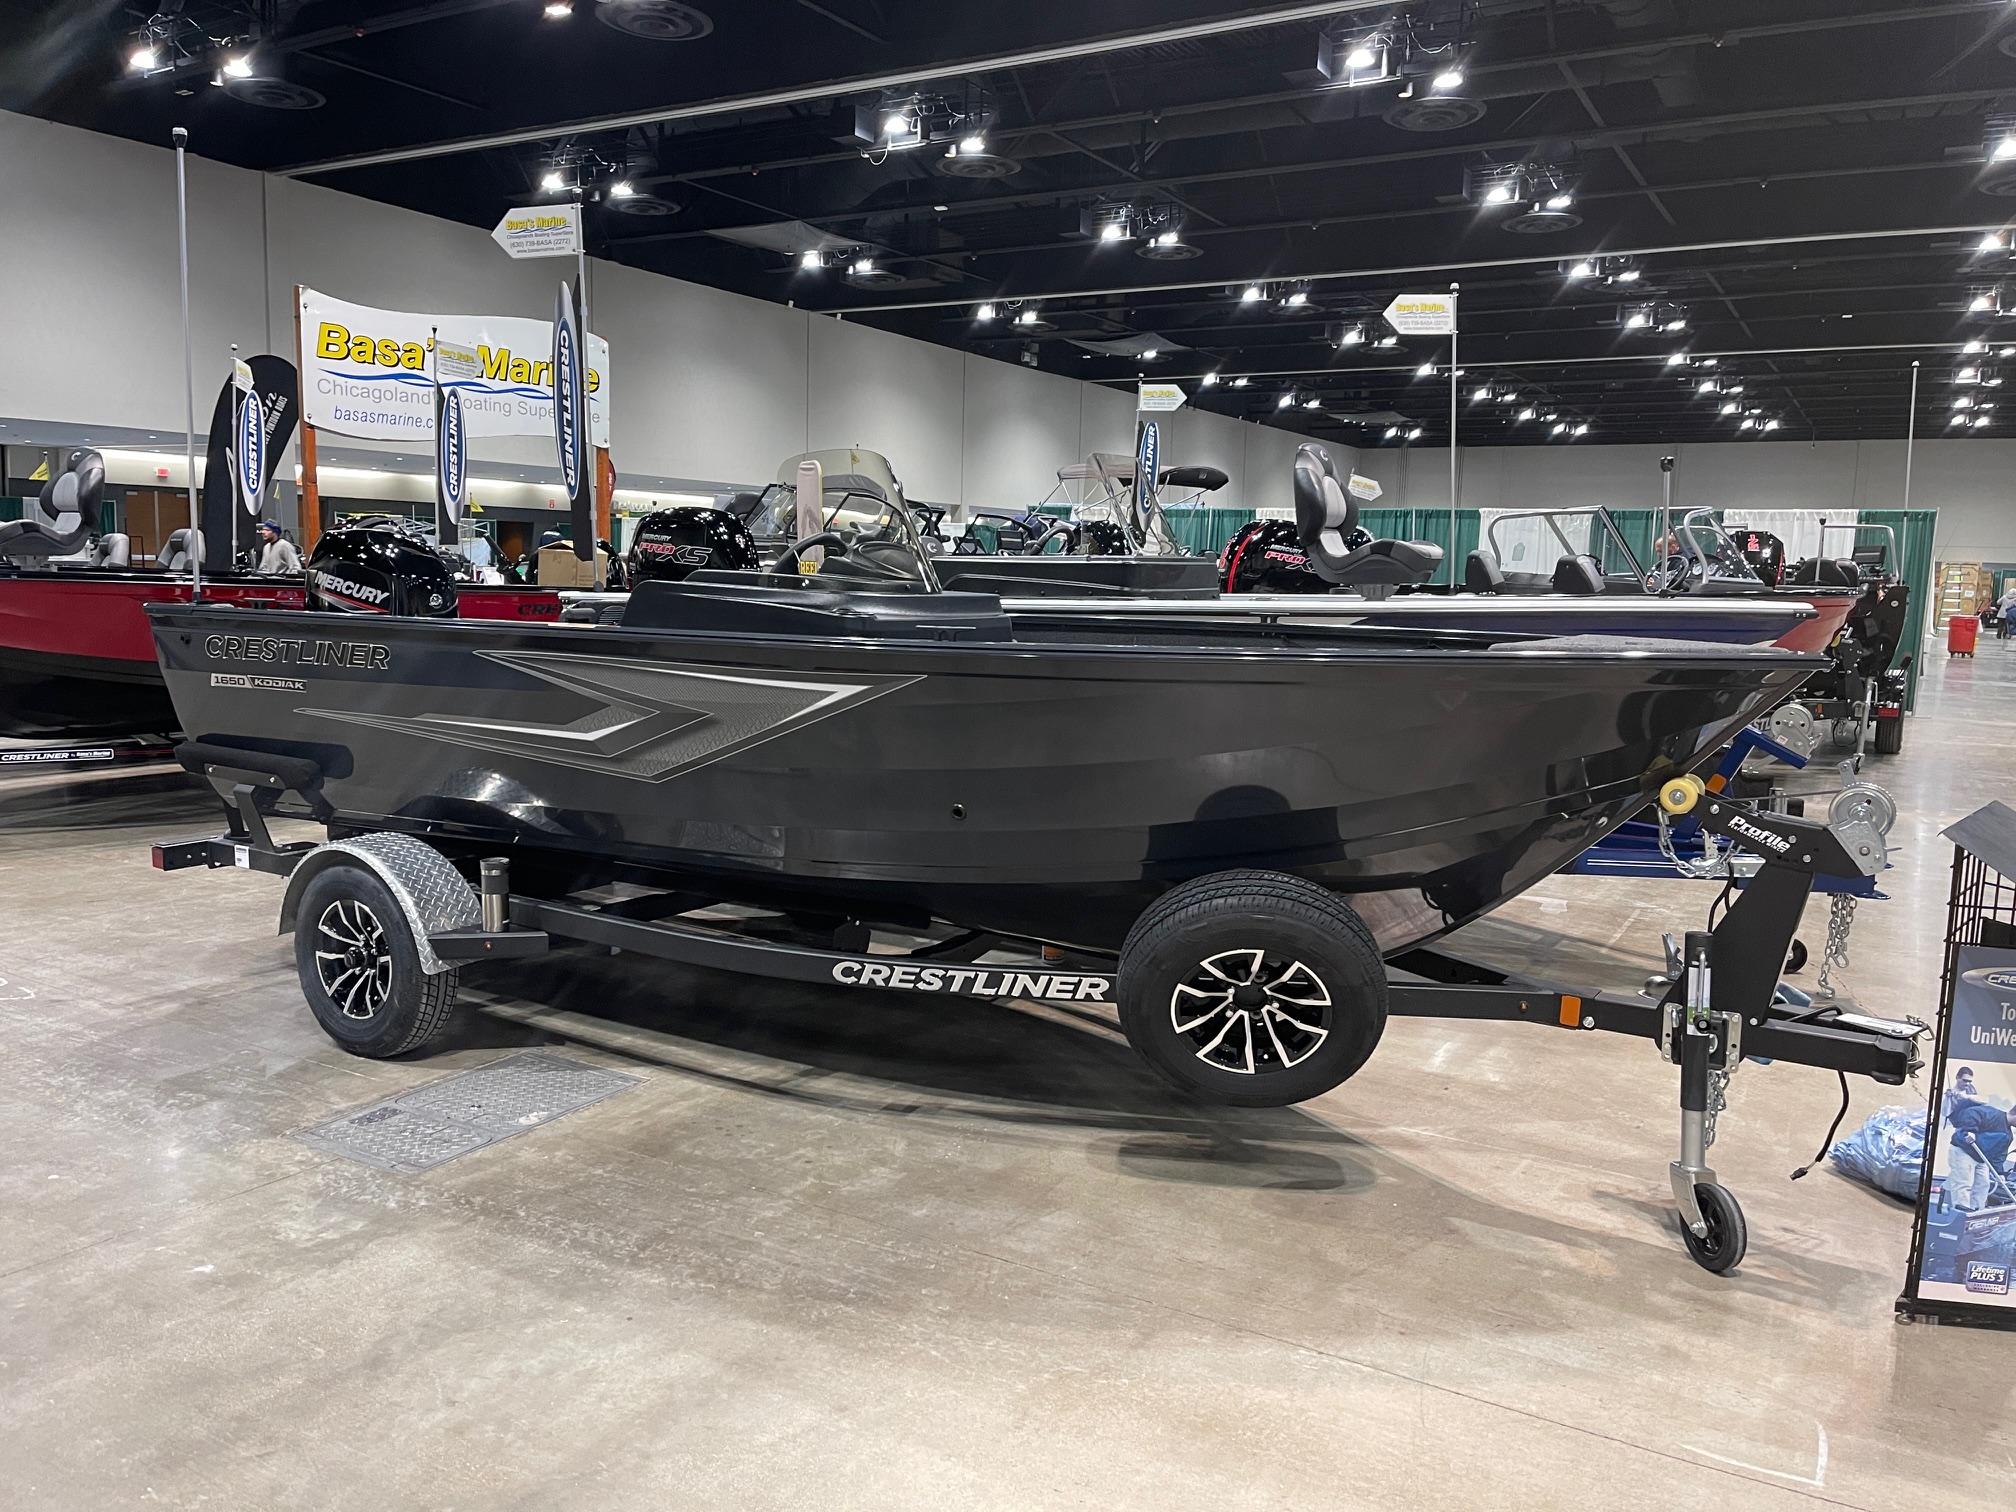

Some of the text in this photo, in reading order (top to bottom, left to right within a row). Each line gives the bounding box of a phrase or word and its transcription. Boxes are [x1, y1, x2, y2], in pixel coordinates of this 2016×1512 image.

[536, 216, 567, 228] Marine
[316, 321, 601, 394] Basa' Marie
[334, 405, 434, 429] basasmarine.c
[463, 397, 513, 418] oating
[559, 329, 576, 487] CRESTLINER
[248, 397, 259, 490] CRESTLINER
[450, 395, 459, 497] CRESTLINER
[1143, 425, 1156, 508] CTLINER
[641, 532, 672, 542] MERCURY
[1270, 543, 1304, 554] MERCURY
[314, 570, 390, 605] MERCURY
[204, 634, 391, 670] CRESTLINER
[213, 675, 305, 690] 1650 KODIAK
[1, 752, 70, 761] CRESTLINER
[1729, 815, 1791, 851] Profile
[831, 961, 1110, 1001] CRESTLINER
[1970, 1271, 2005, 1282] PLUS 3
[1971, 1265, 2006, 1275] Lifetime
